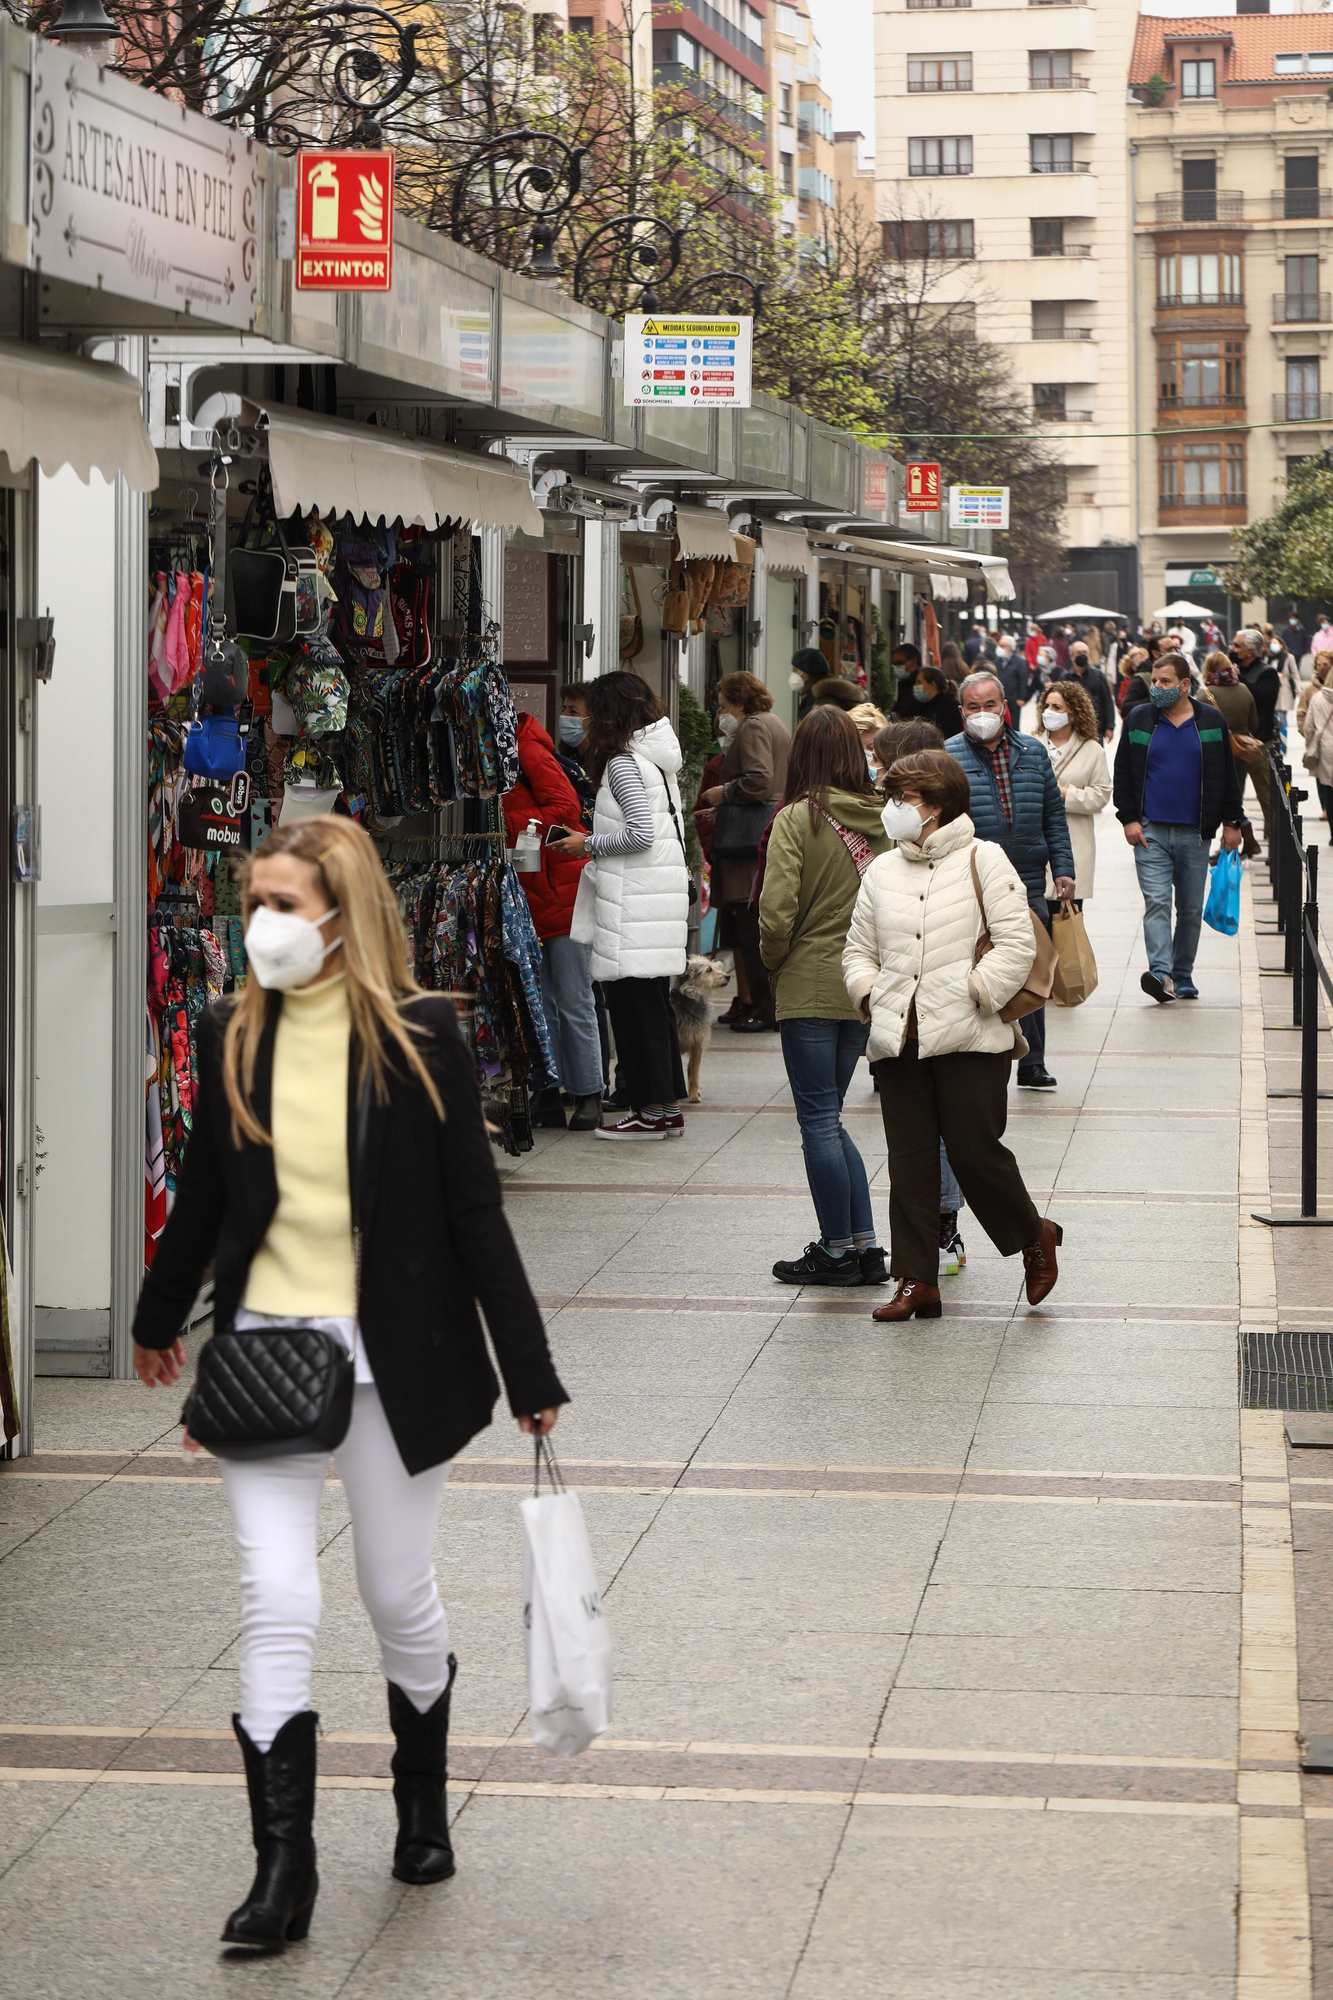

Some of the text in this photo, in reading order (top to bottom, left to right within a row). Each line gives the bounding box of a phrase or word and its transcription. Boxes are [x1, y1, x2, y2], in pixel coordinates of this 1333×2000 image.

[63, 116, 237, 242] ARTESANIA EN PIEL
[303, 260, 385, 278] EXTINTOR
[662, 324, 685, 332] MEDIDAS
[686, 324, 714, 332] SEGURIDAD
[397, 597, 414, 628] ROCKS
[237, 779, 246, 804] möbus
[206, 825, 241, 845] möbus
